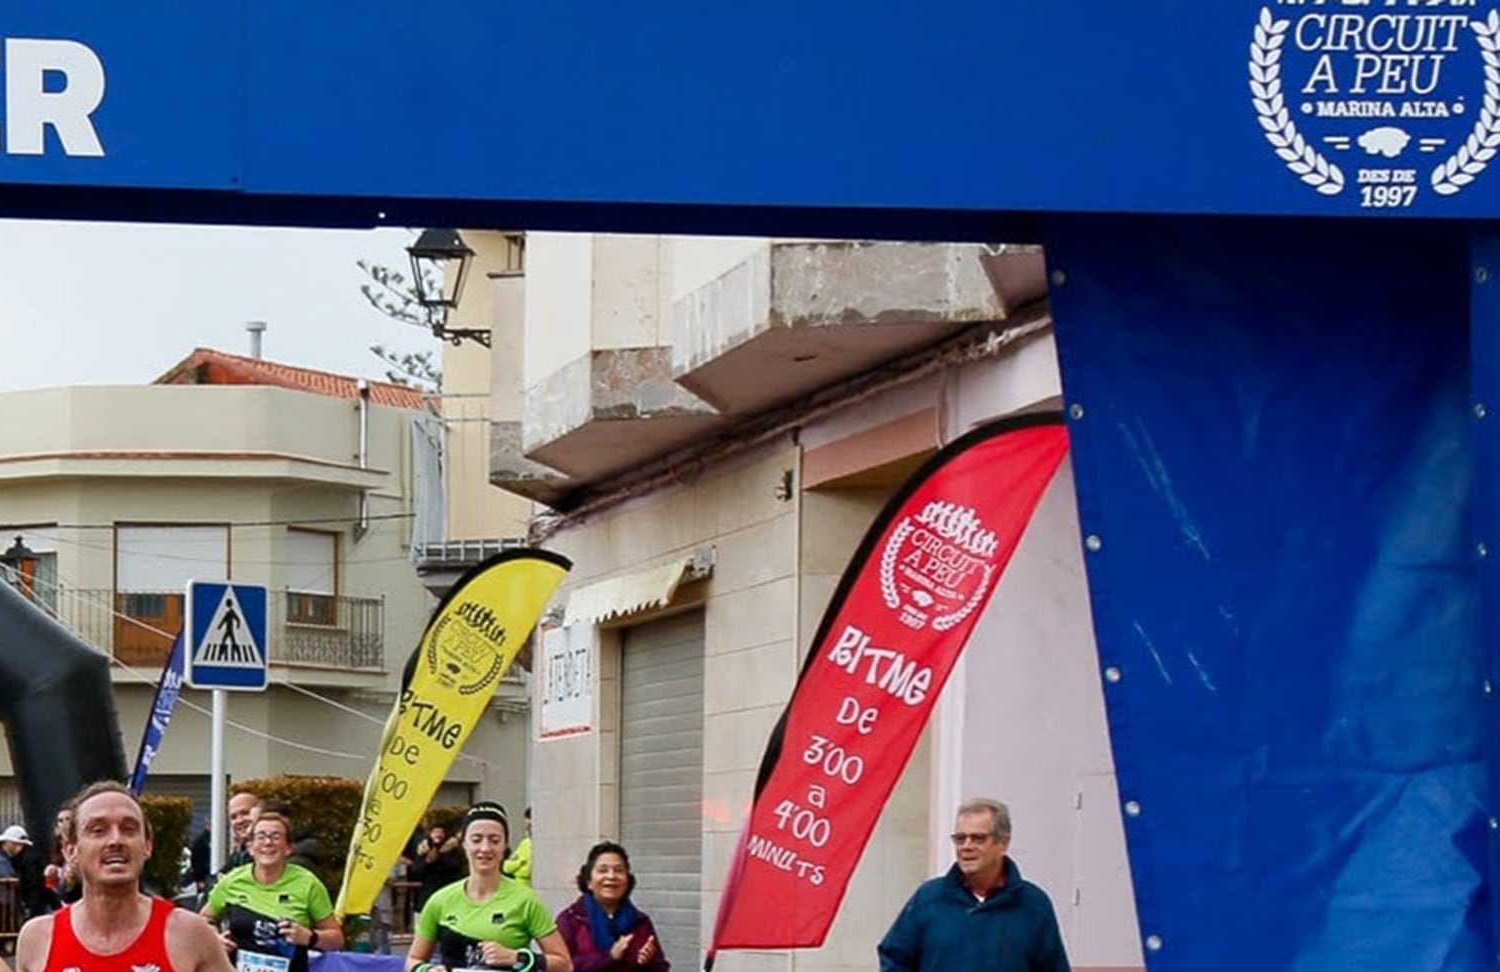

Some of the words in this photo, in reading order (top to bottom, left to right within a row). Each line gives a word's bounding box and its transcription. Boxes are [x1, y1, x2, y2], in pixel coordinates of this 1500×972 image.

[1295, 13, 1468, 51] CIRCUIT
[1301, 54, 1339, 93] A
[1349, 54, 1444, 94] PEU
[1316, 101, 1396, 117] MARINA
[1399, 101, 1449, 117] ALTA
[1360, 186, 1417, 207] 1997
[911, 528, 986, 575] CIRCUIT
[920, 556, 967, 589] PEU
[827, 625, 932, 705] RITME
[803, 735, 864, 785] 3'00
[774, 800, 831, 848] 4'00
[747, 835, 826, 886] MINUTS
